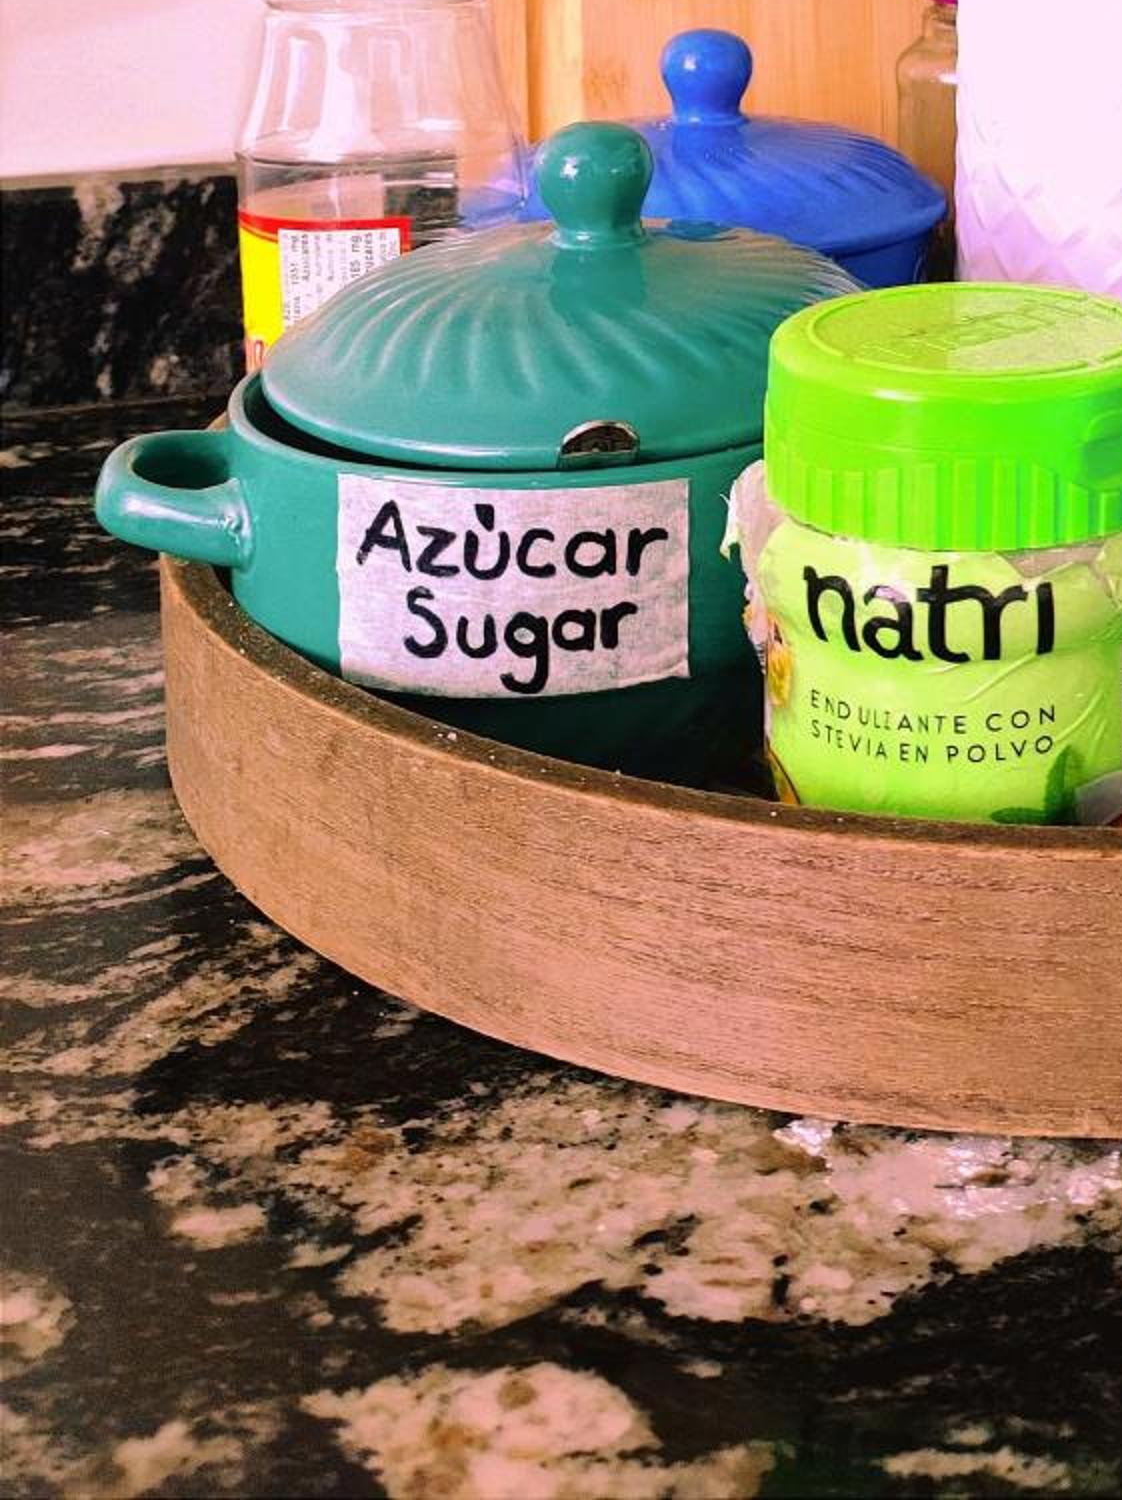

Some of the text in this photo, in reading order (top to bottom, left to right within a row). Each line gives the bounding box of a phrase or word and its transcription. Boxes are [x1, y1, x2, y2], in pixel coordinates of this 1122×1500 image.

[404, 586, 638, 694] Sugar
[986, 705, 1055, 732] CON
[811, 719, 1053, 763] STEVIA EN POLVO
